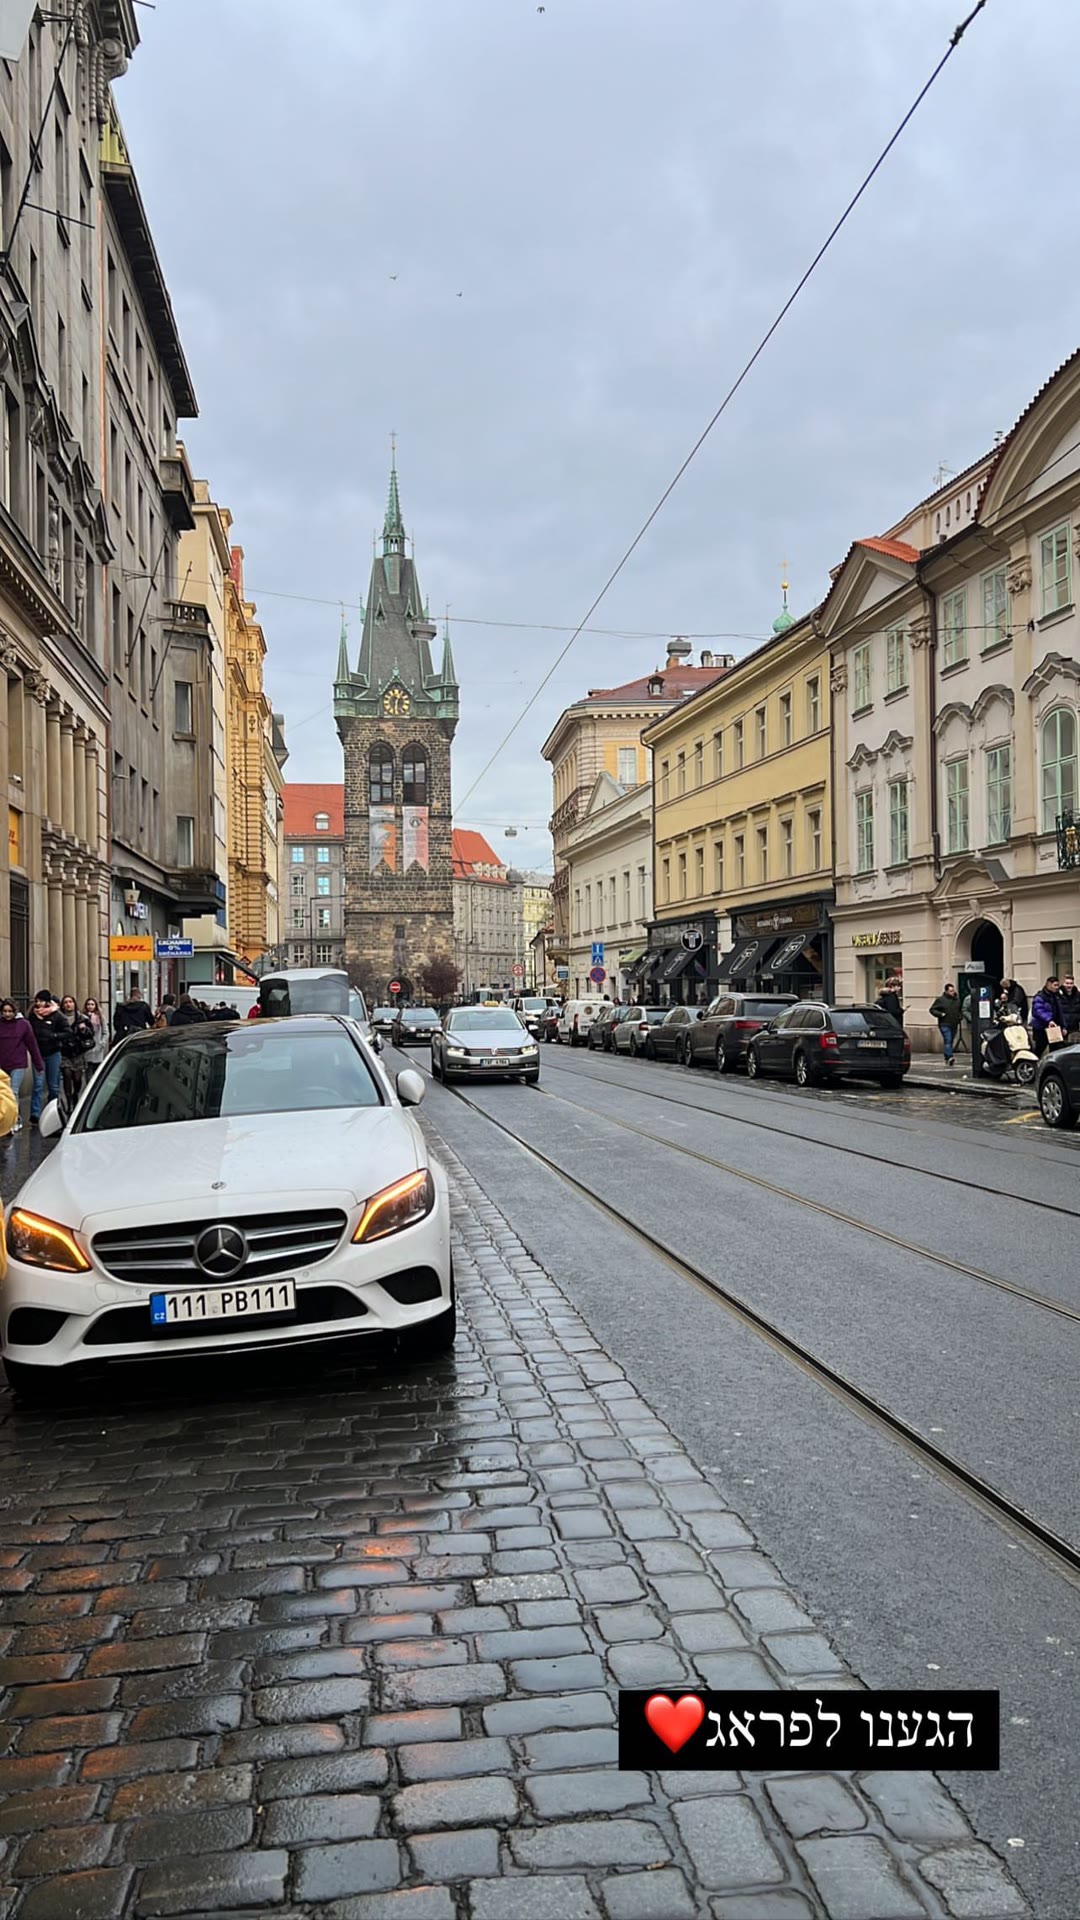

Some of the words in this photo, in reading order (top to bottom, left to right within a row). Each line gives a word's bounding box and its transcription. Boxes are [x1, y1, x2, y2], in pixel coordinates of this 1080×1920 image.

[116, 944, 146, 952] DHL
[980, 987, 987, 997] P
[168, 1295, 206, 1318] 111
[221, 1286, 289, 1314] PB111
[154, 1312, 165, 1320] CZ
